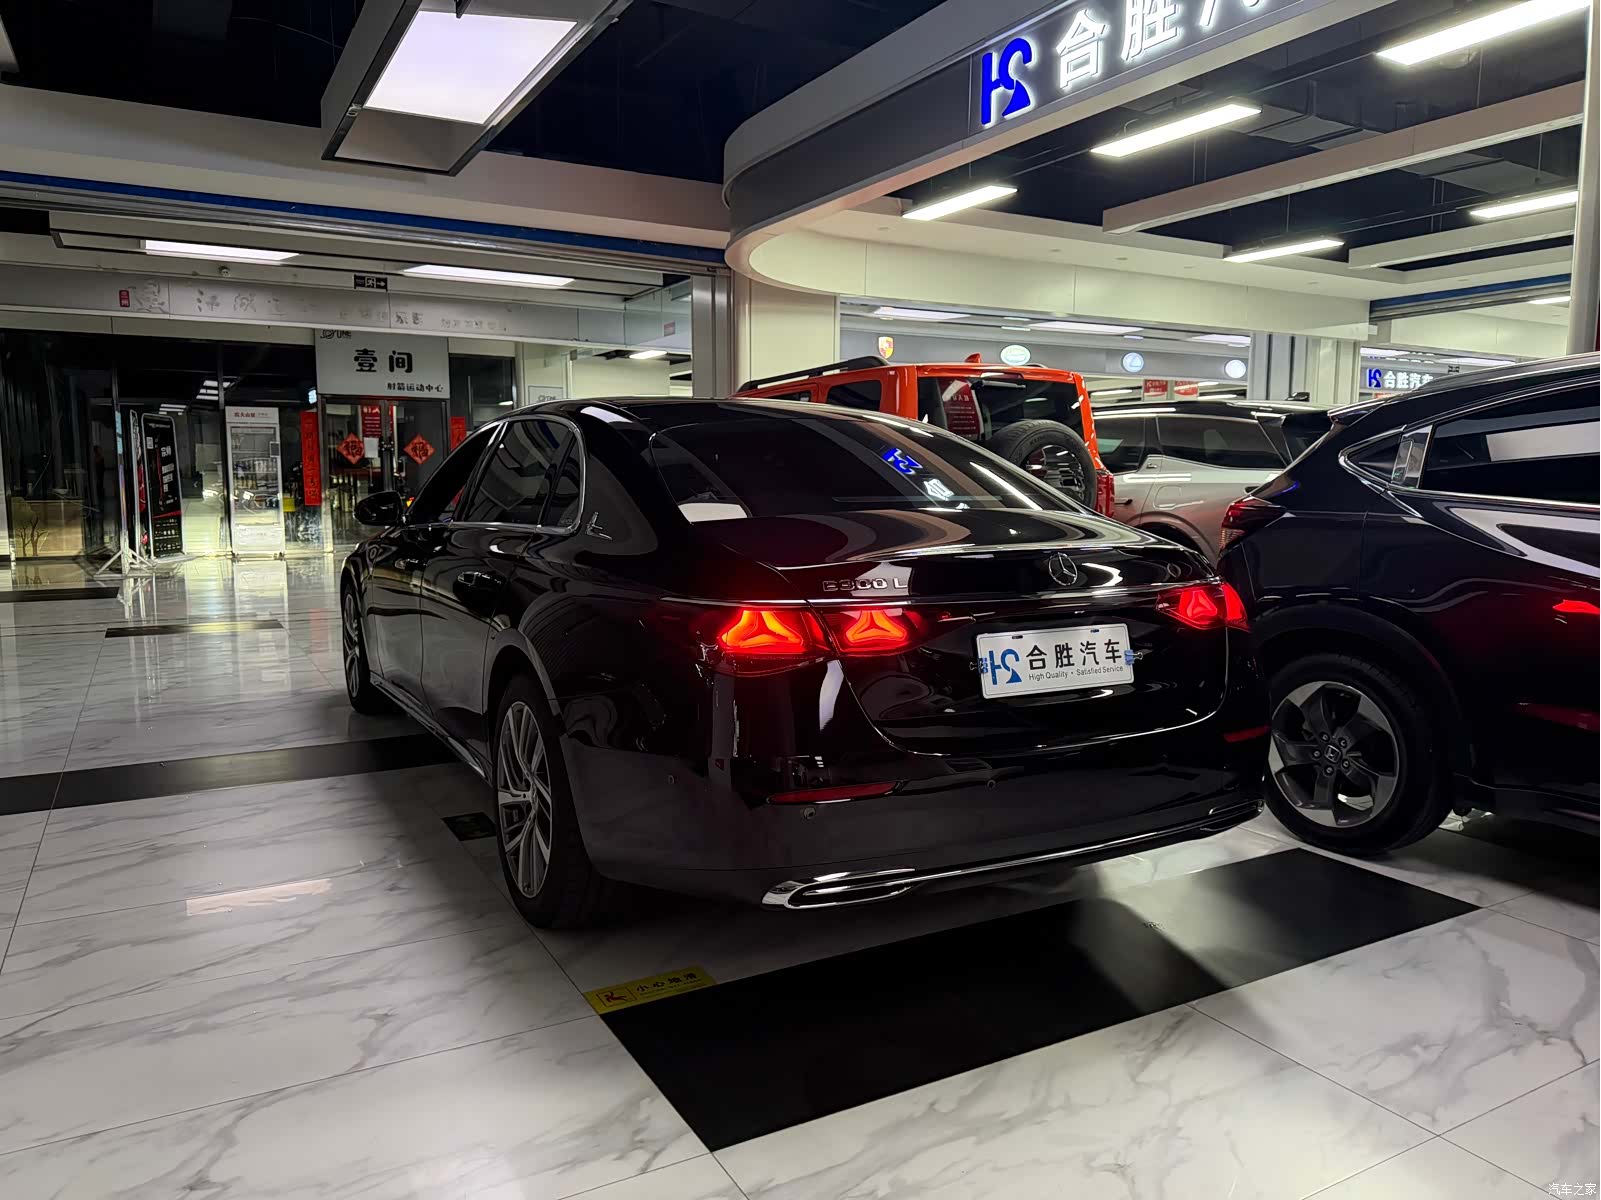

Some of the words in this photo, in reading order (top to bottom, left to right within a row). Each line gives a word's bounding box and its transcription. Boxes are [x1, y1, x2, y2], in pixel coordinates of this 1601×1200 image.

[387, 382, 444, 393] 射箭运动中心
[893, 577, 908, 589] L
[1026, 639, 1122, 670] 合胜汽车
[1029, 672, 1045, 681] High
[1045, 670, 1068, 679] Quality
[1076, 667, 1102, 676] Satisfied
[1102, 665, 1124, 673] Service
